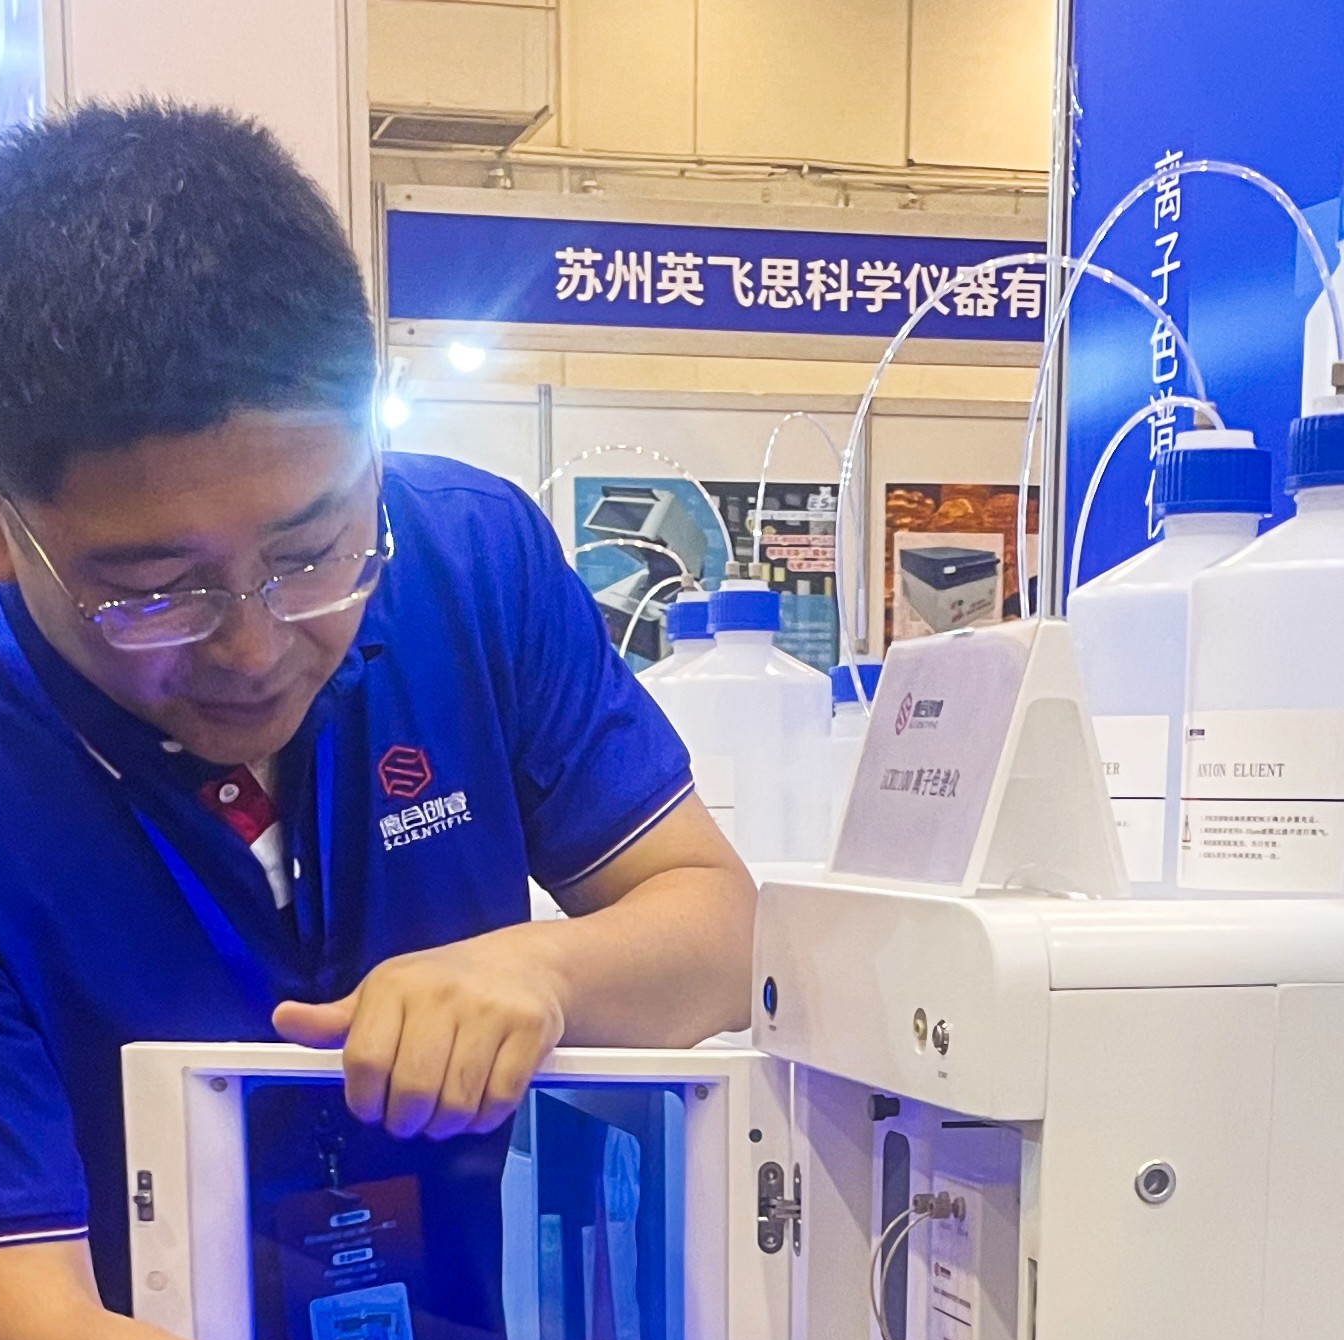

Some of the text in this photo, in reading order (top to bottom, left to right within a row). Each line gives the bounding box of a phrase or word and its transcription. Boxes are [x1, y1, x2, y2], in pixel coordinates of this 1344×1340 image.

[555, 246, 1045, 319] 苏州英飞思科学仪器有
[1233, 763, 1285, 778] ELUENT
[383, 810, 473, 851] SCIENTIFIC
